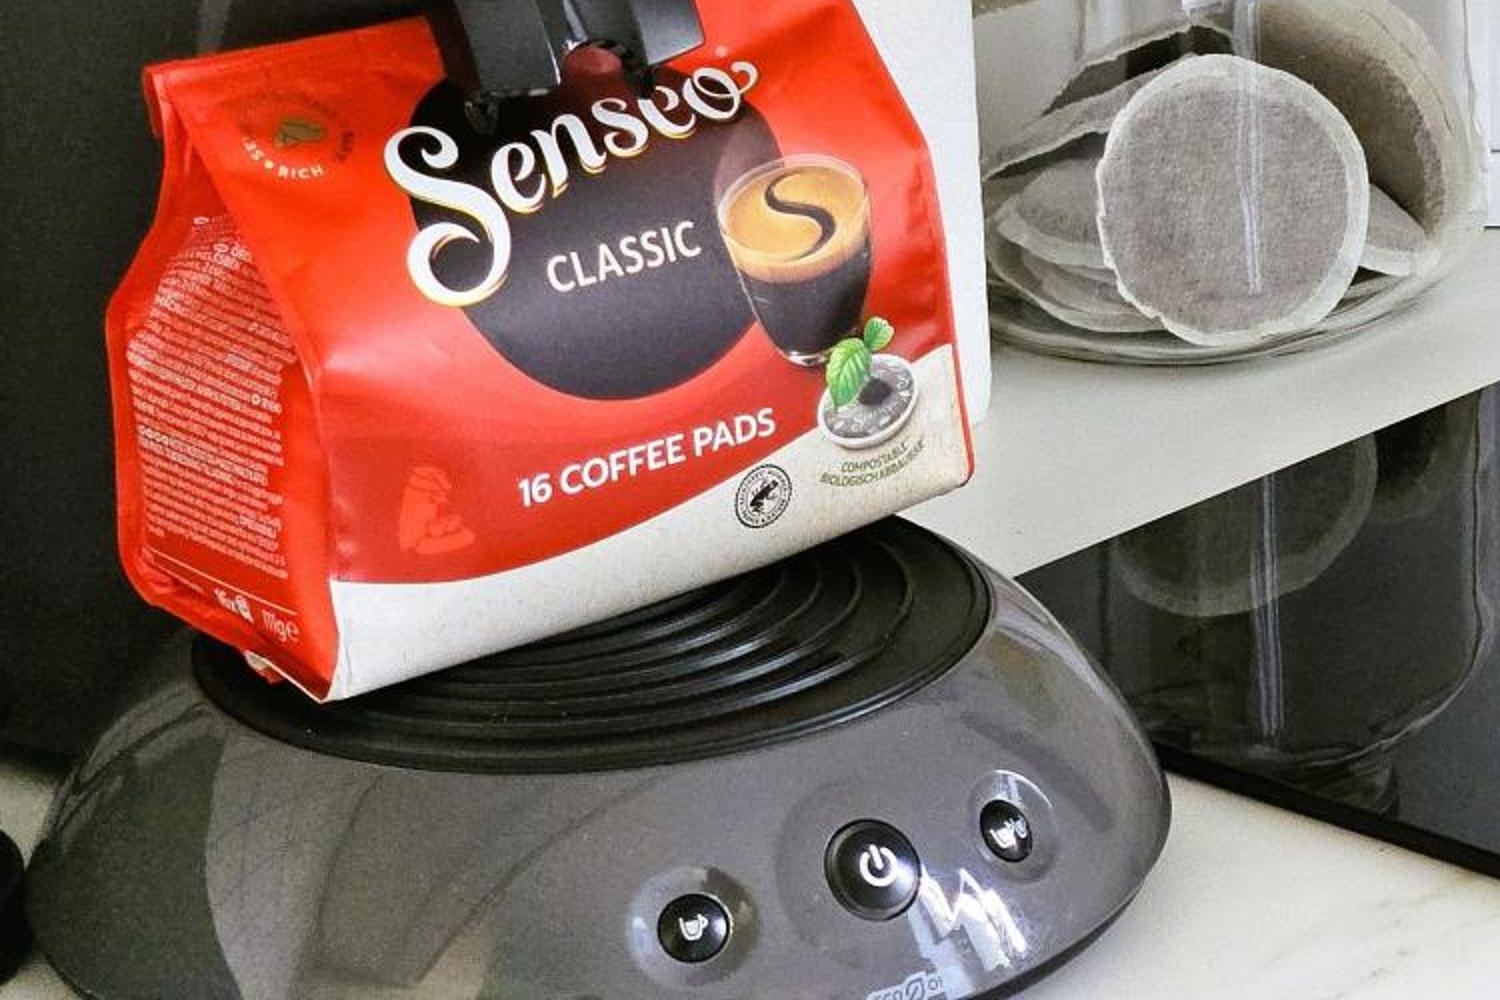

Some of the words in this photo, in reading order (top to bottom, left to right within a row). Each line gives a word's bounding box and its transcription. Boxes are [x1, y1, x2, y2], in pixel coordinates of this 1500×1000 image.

[384, 61, 759, 308] Senseo
[546, 220, 702, 293] CLASSIC
[518, 472, 553, 507] 16
[559, 433, 687, 495] COFFEE
[692, 407, 777, 457] PADS
